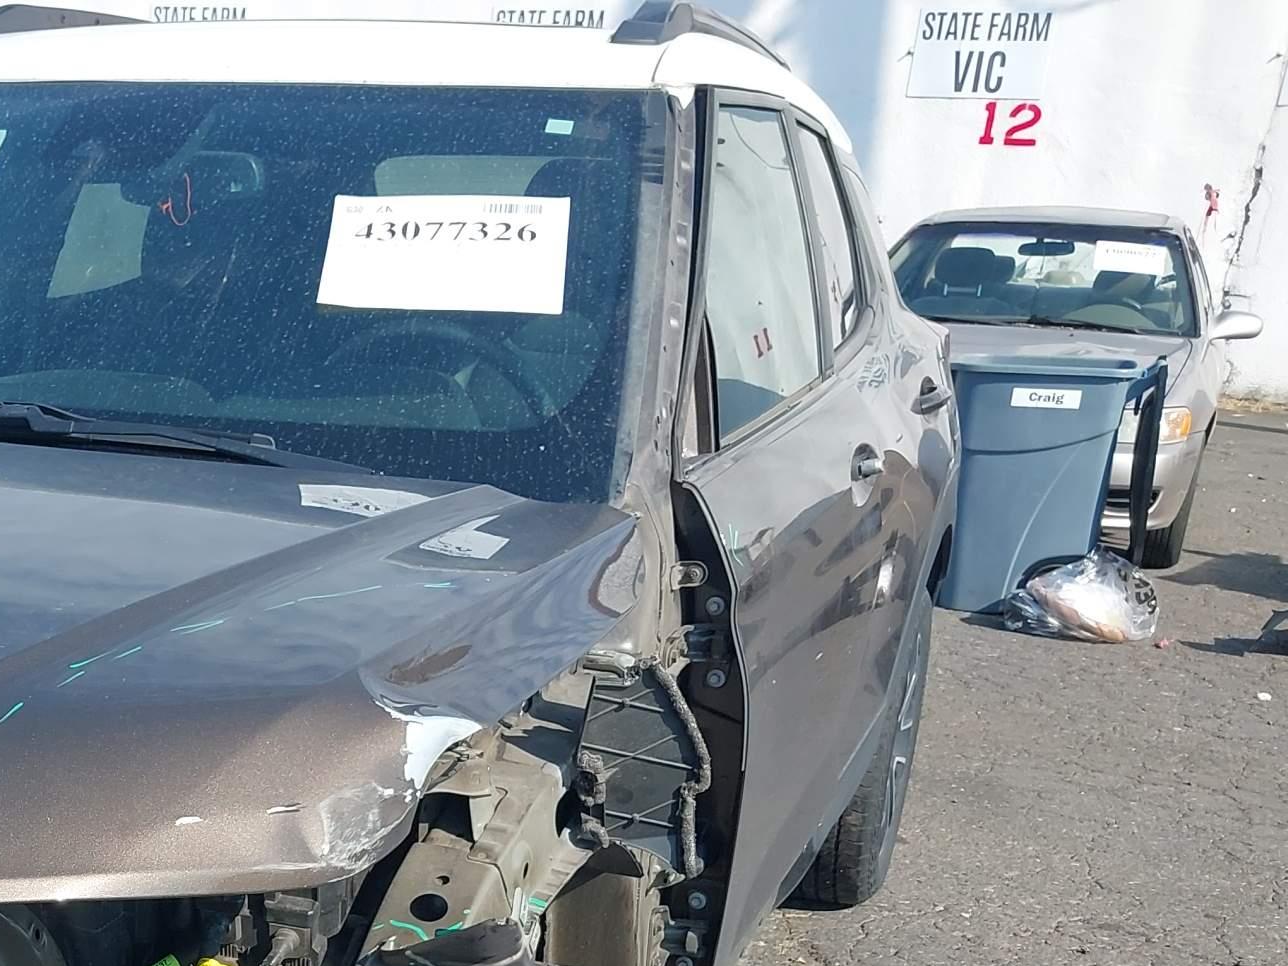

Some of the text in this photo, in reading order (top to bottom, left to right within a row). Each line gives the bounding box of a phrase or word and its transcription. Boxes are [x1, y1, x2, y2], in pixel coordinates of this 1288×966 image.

[922, 11, 1053, 42] STATE FARM
[954, 50, 1007, 93] VIC
[978, 101, 1042, 146] 12
[354, 220, 537, 242] 43077326
[1028, 391, 1065, 405] Craig
